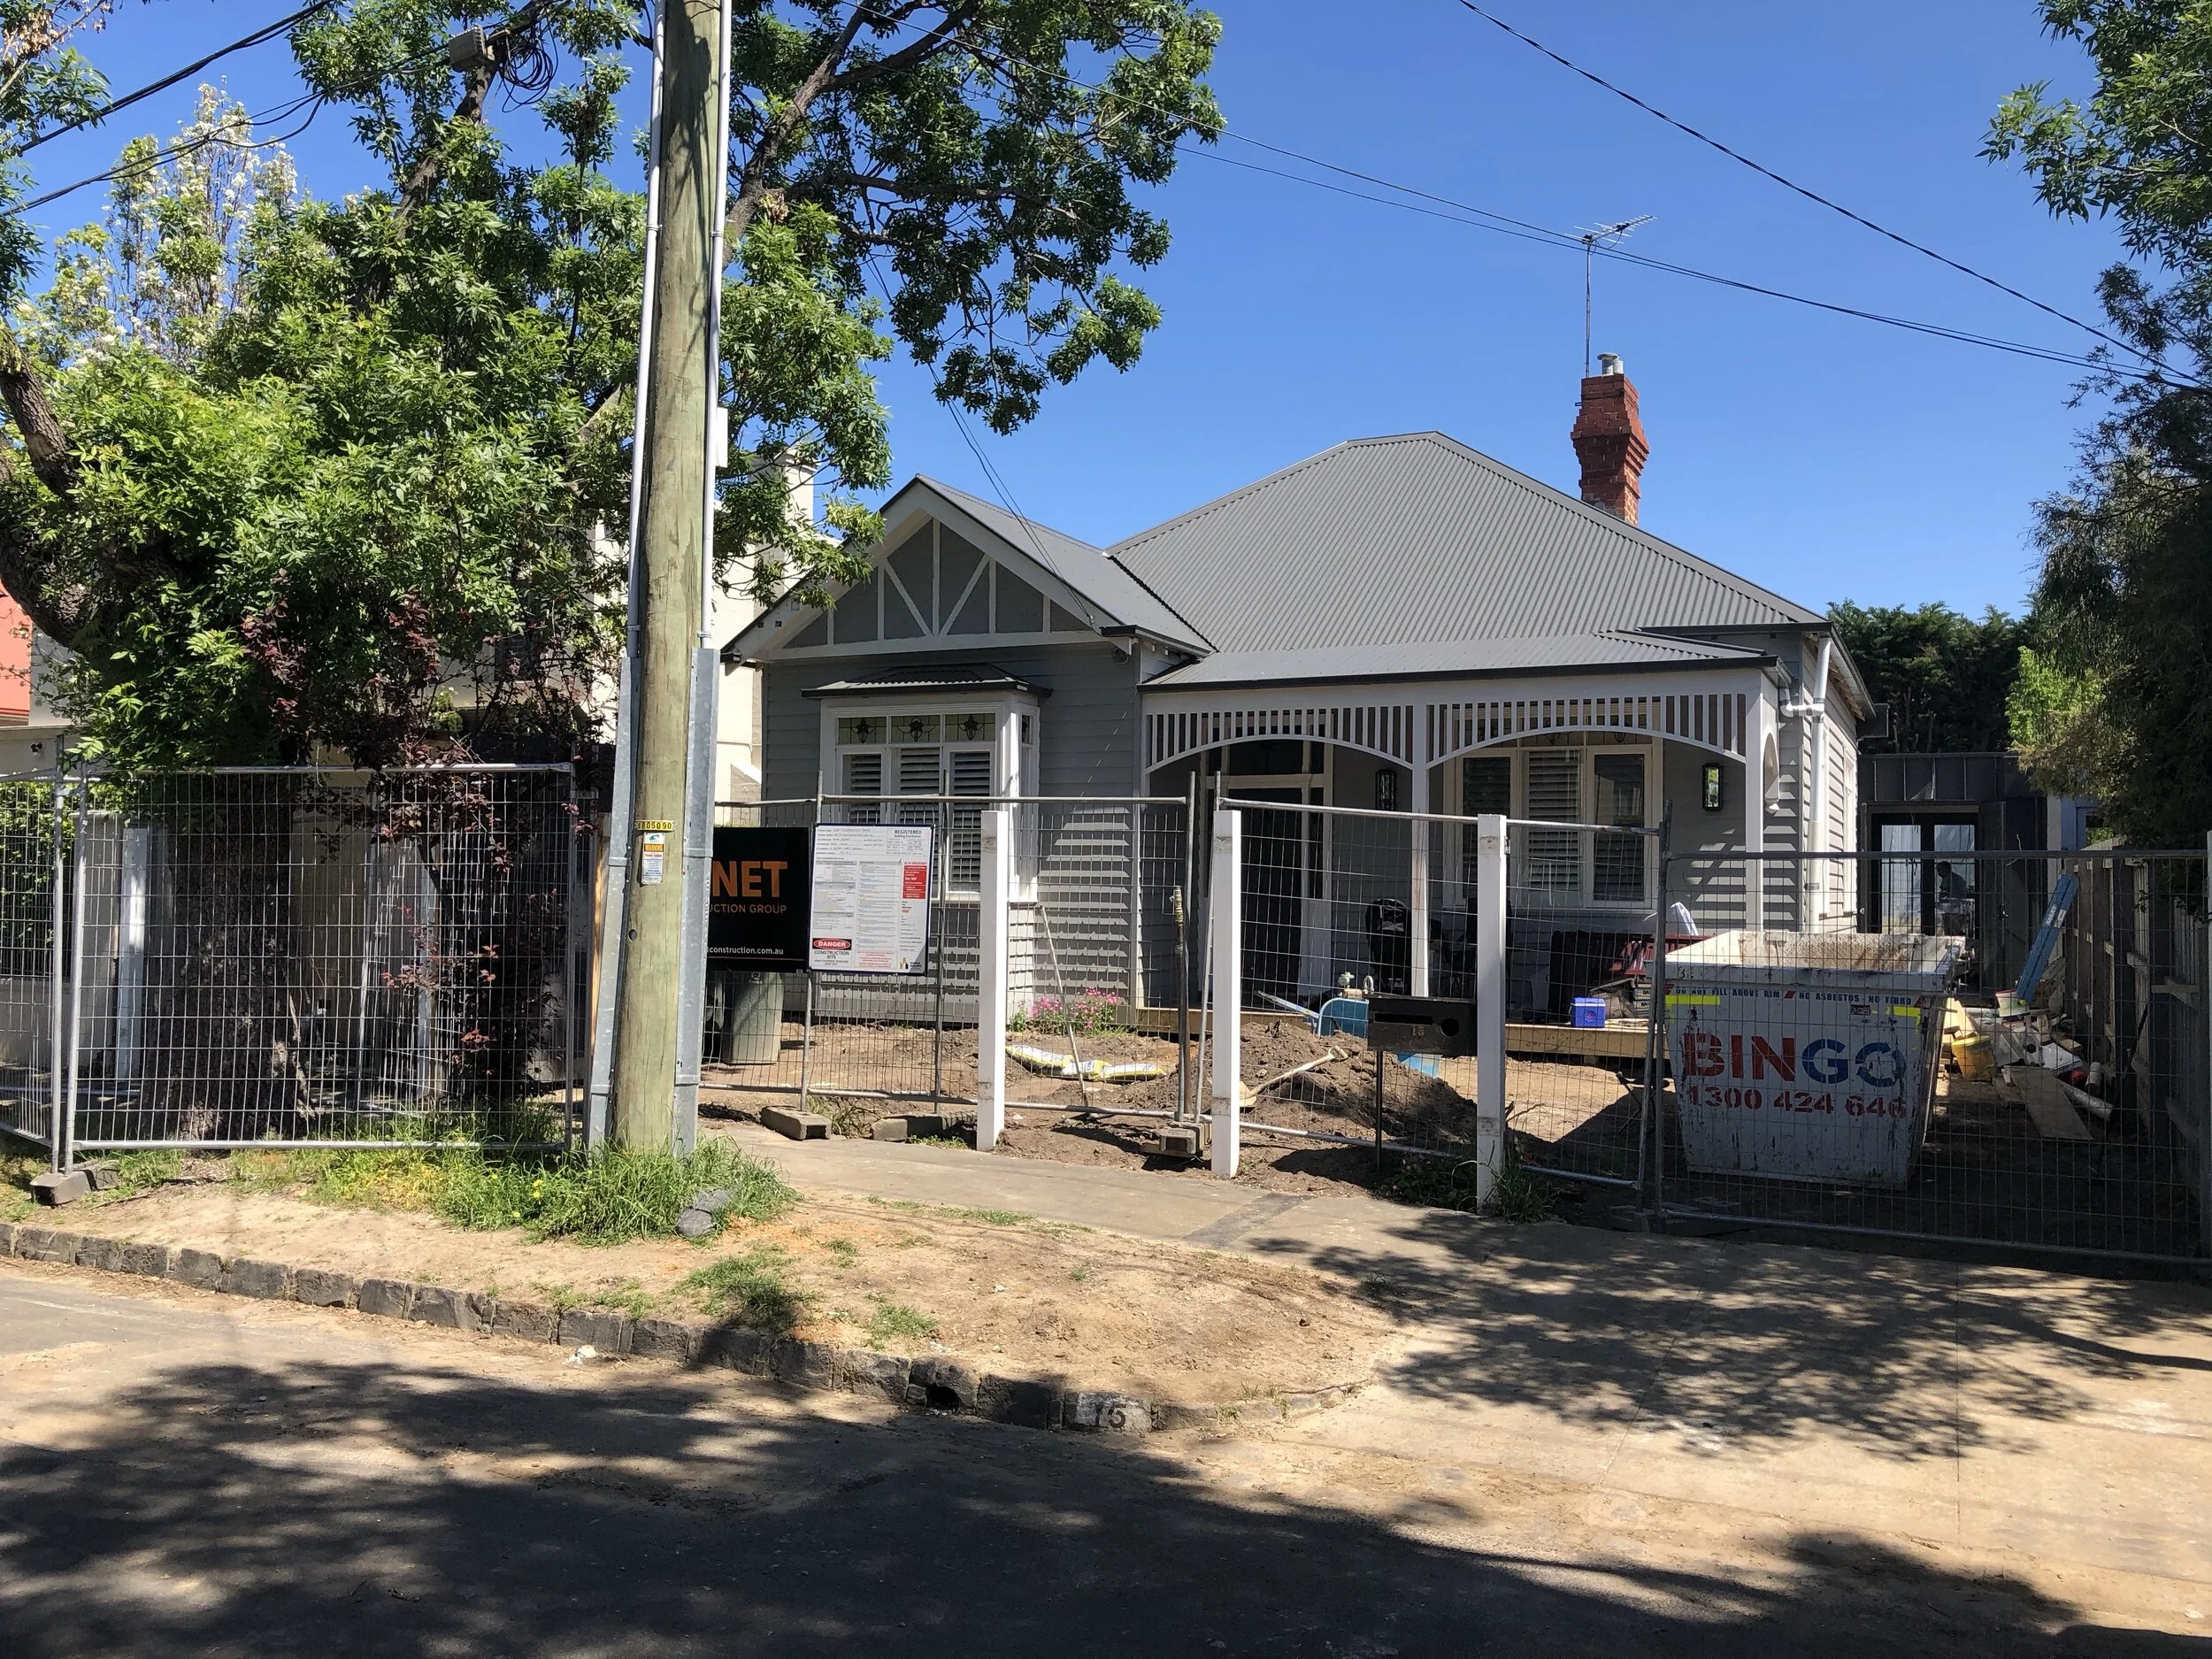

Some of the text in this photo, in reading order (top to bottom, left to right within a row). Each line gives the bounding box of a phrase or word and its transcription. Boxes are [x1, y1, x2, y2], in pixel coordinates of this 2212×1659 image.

[637, 821, 672, 830] 1805090
[749, 903, 787, 914] GROUP
[1733, 987, 1759, 997] ABOVE
[1763, 989, 1780, 998] RIM
[1815, 993, 1860, 1002] ASBESTOS
[1885, 996, 1912, 1005] FIBRO
[1683, 1033, 1907, 1088] BINGO
[1686, 1085, 1908, 1119] 1300 424 646
